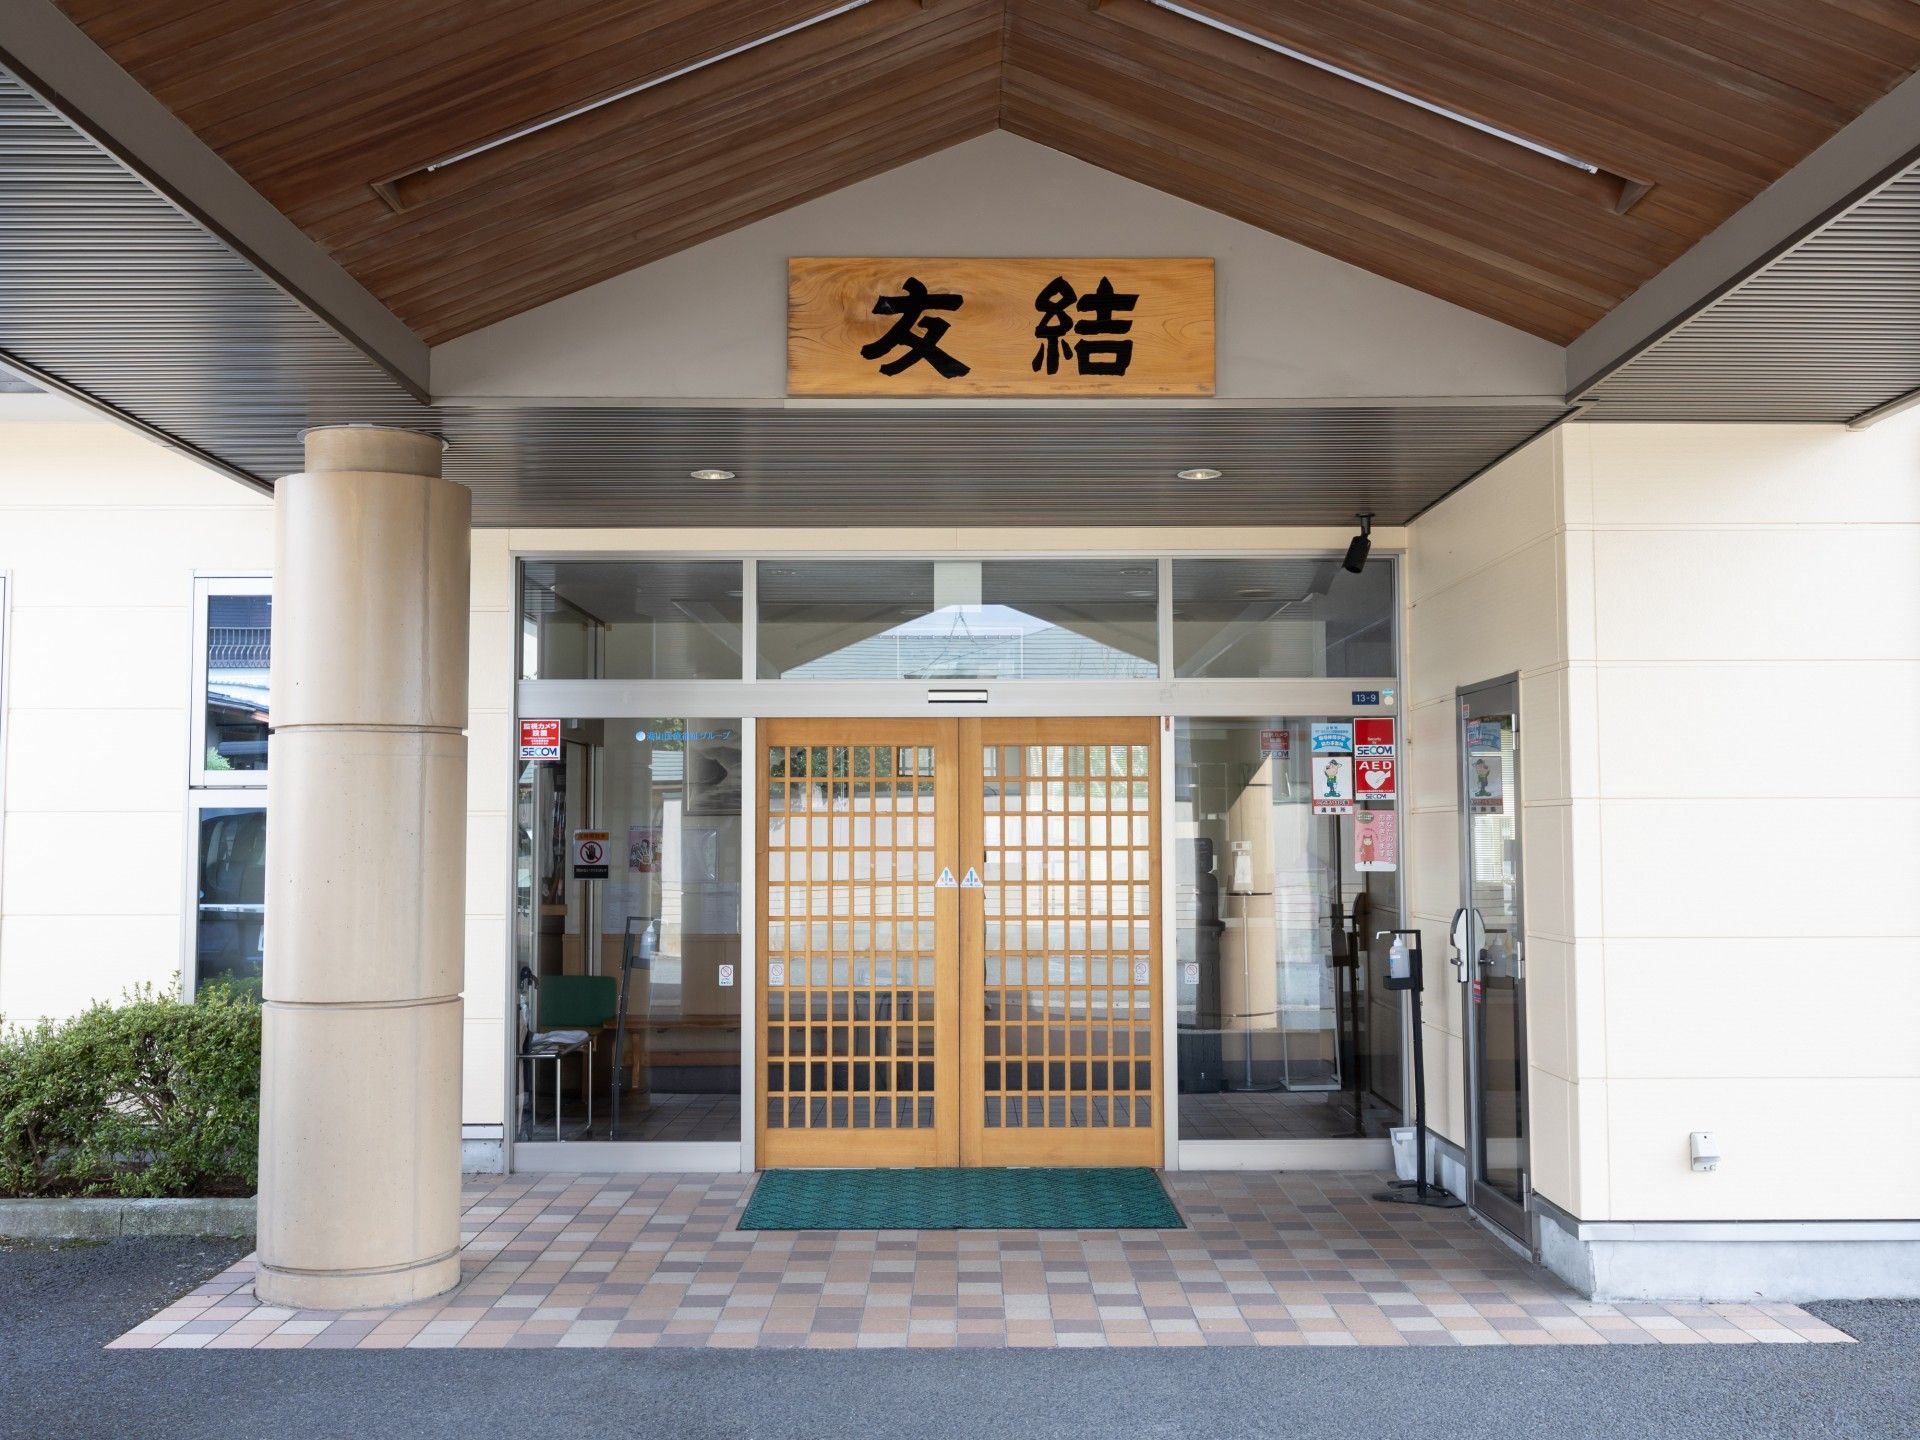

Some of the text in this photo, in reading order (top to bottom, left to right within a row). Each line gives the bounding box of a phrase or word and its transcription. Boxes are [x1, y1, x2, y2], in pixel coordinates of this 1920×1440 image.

[1355, 693, 1377, 703] 13-9
[522, 747, 557, 757] SECOM
[1357, 745, 1393, 755] SECOM
[1358, 761, 1392, 770] AED
